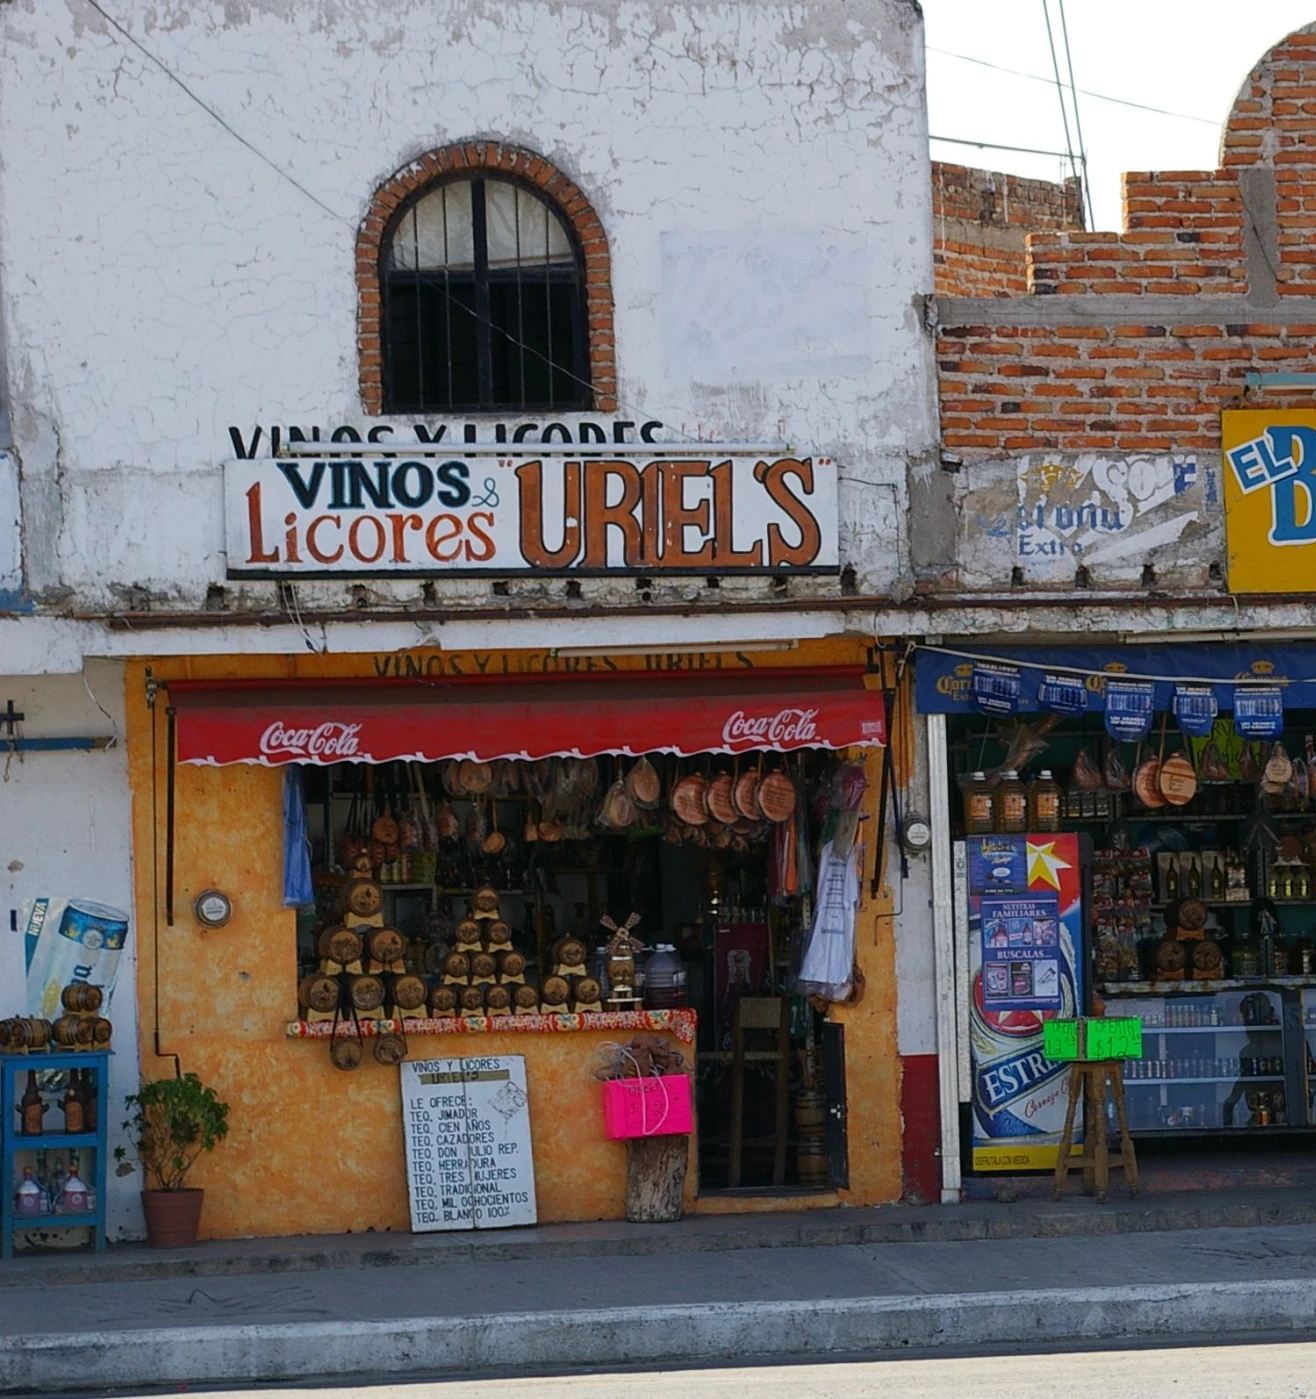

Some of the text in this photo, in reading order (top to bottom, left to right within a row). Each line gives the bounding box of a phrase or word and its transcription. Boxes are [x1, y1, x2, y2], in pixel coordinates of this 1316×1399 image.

[413, 424, 448, 459] Y
[1228, 438, 1298, 492] EL
[276, 460, 501, 510] VINOS &
[244, 481, 498, 565] Licores
[473, 654, 493, 676] Y
[722, 707, 820, 743] Coca-Cola
[260, 721, 363, 756] Coca-Cola
[27, 901, 47, 936] NUEVA
[992, 910, 1047, 918] FAMILIARES
[412, 1058, 500, 1073] VINOS Y LICORES
[410, 1098, 424, 1110] LE
[438, 1108, 478, 1120] JIMADOR
[438, 1122, 460, 1134] CIEN
[436, 1132, 495, 1146] CAZADORES
[437, 1147, 458, 1158] DON
[440, 1171, 465, 1184] TRES
[440, 1182, 503, 1196] TRADICIONAL
[442, 1197, 458, 1209] MIL
[461, 1192, 529, 1208] OCHOCIENTOS
[443, 1208, 483, 1222] BLANCO
